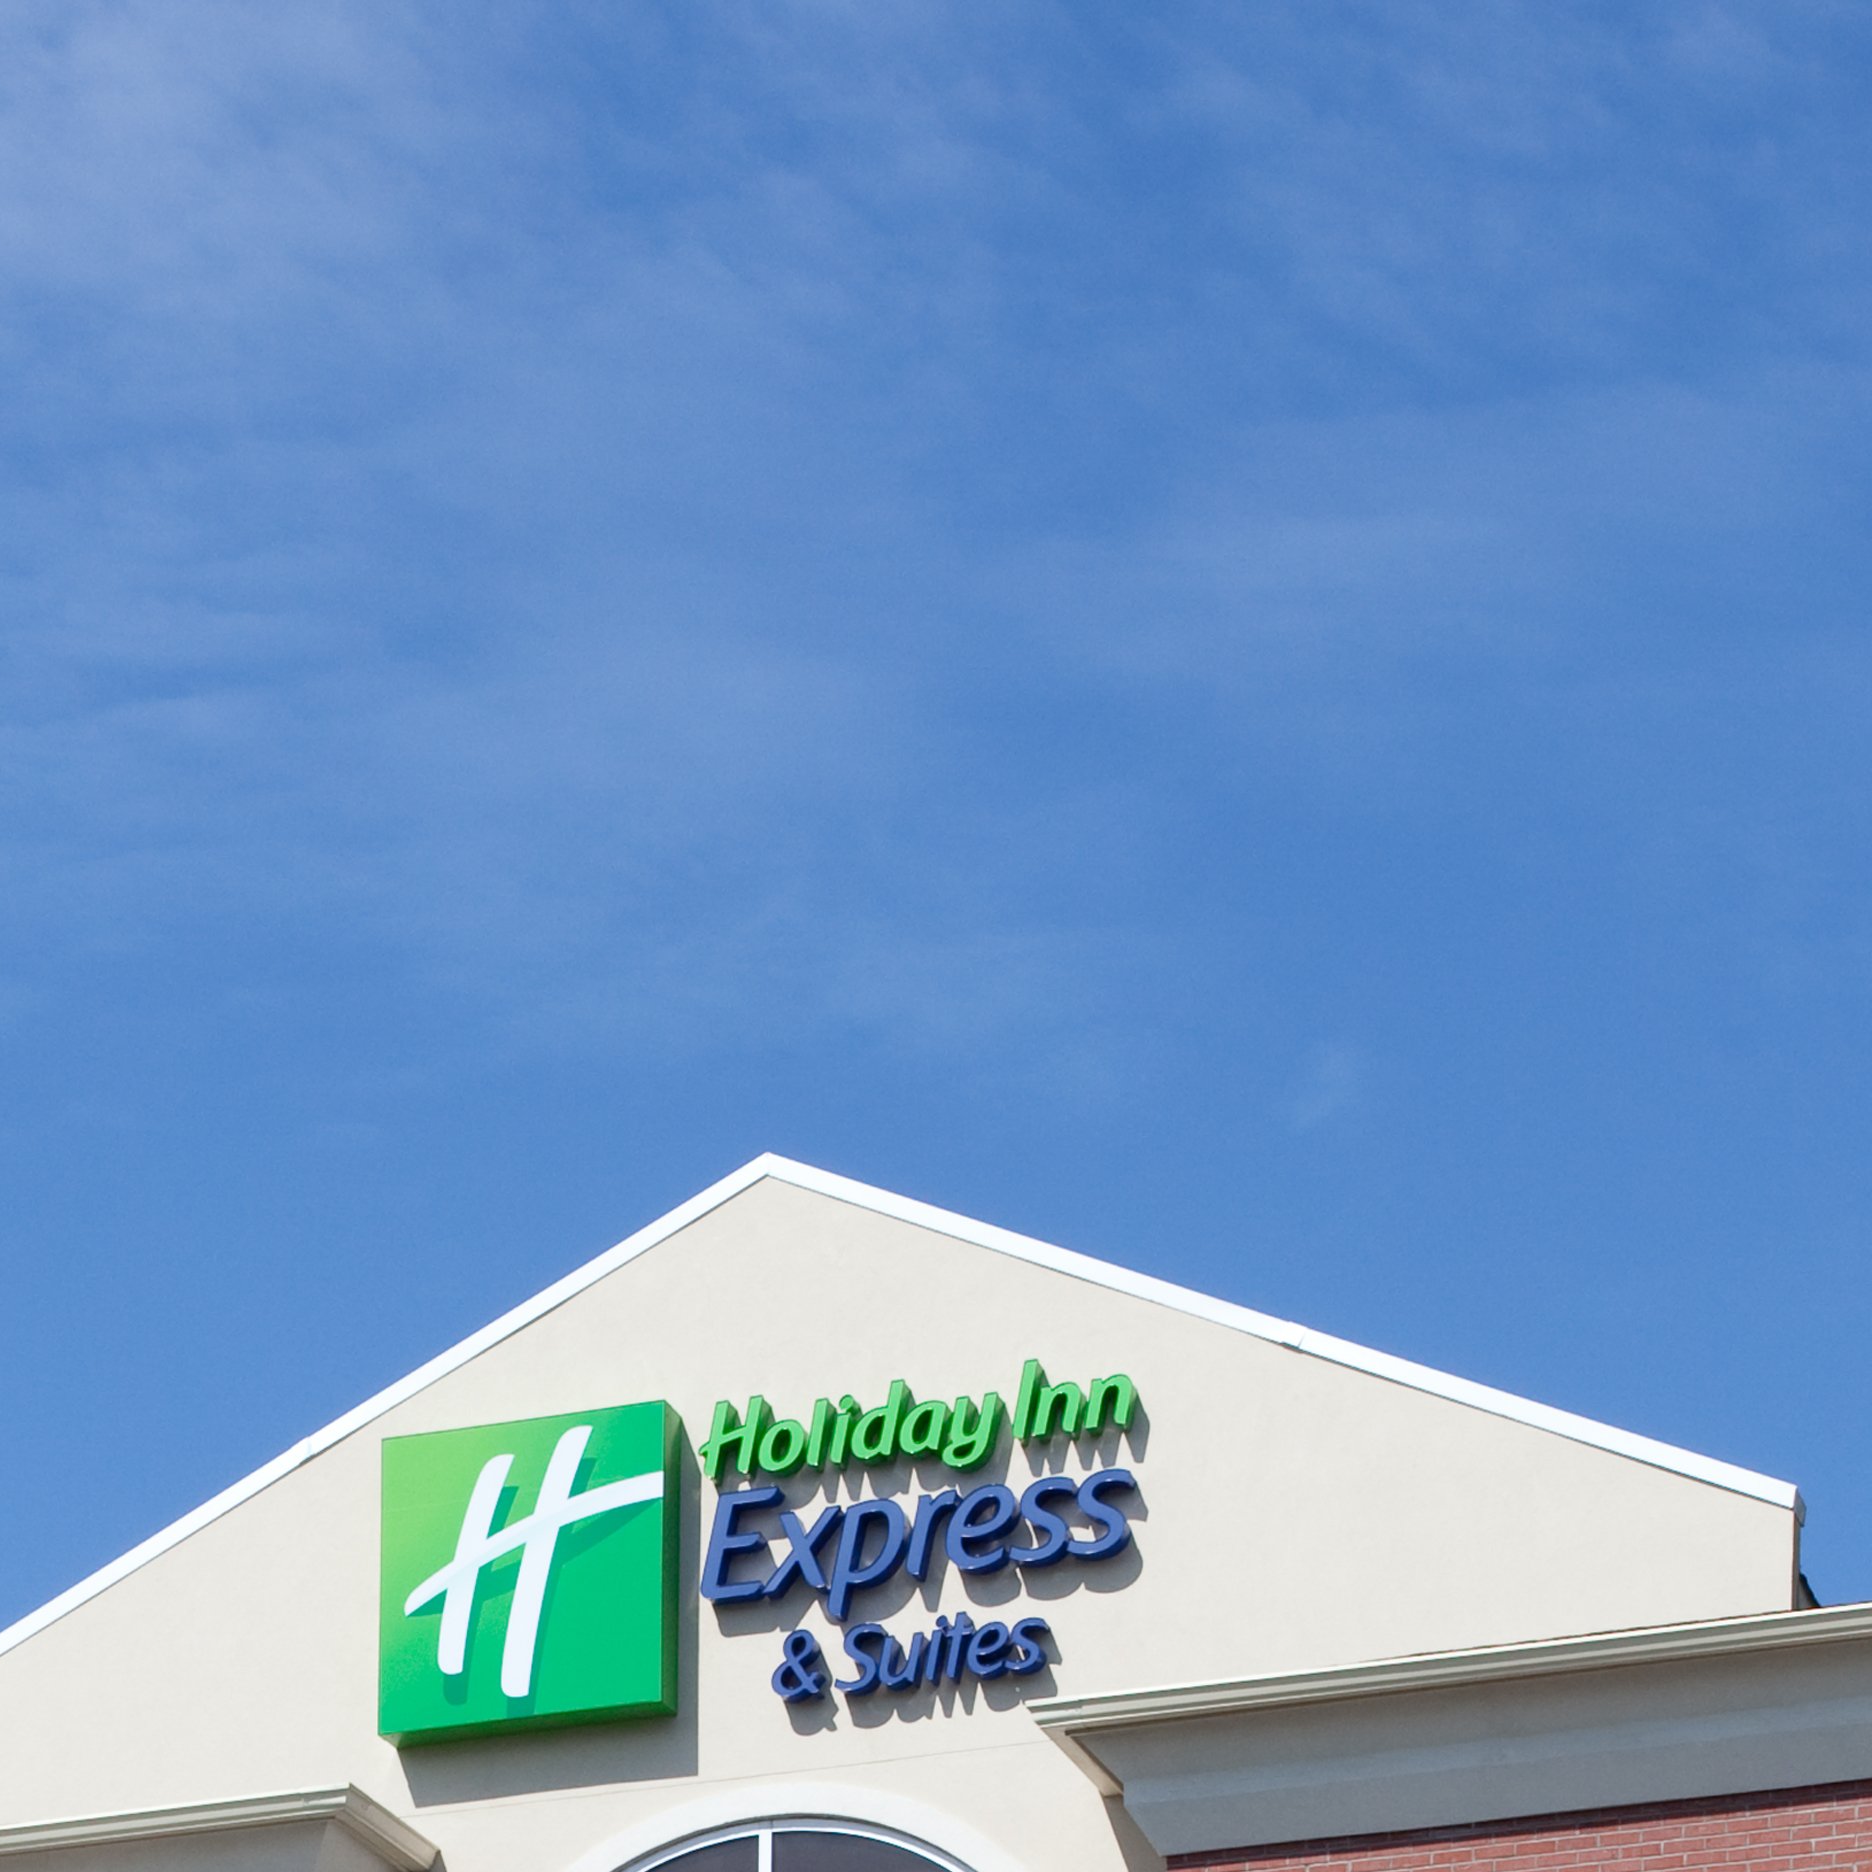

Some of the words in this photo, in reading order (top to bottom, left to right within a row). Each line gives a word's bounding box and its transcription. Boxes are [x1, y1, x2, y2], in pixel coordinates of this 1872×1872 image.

[699, 1379, 1002, 1482] Holiday
[1012, 1358, 1137, 1443] Inn
[700, 1468, 1137, 1621] Express
[771, 1629, 827, 1703] &
[836, 1612, 1050, 1696] Suites
